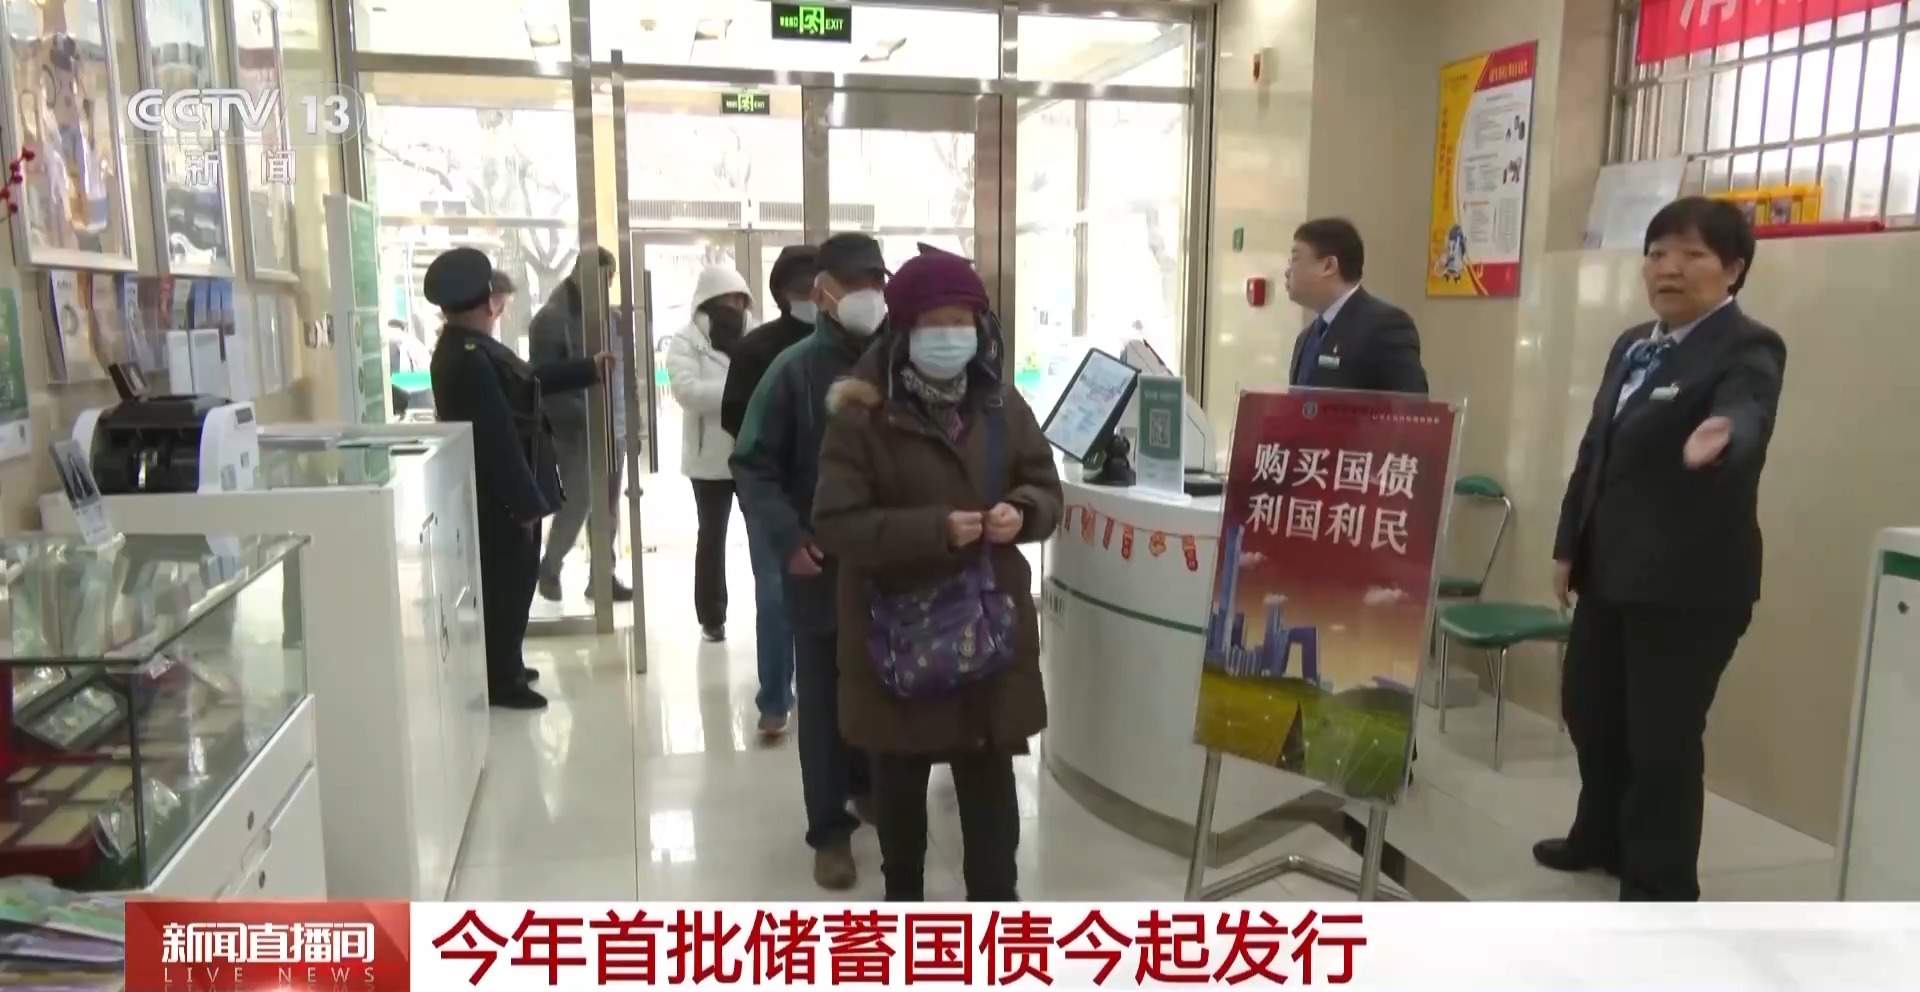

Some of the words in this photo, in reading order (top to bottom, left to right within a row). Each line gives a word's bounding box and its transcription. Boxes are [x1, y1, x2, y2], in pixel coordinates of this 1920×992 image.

[825, 18, 844, 31] EXIT
[1251, 442, 1419, 500] 购买国债
[1245, 492, 1409, 555] 利国利民
